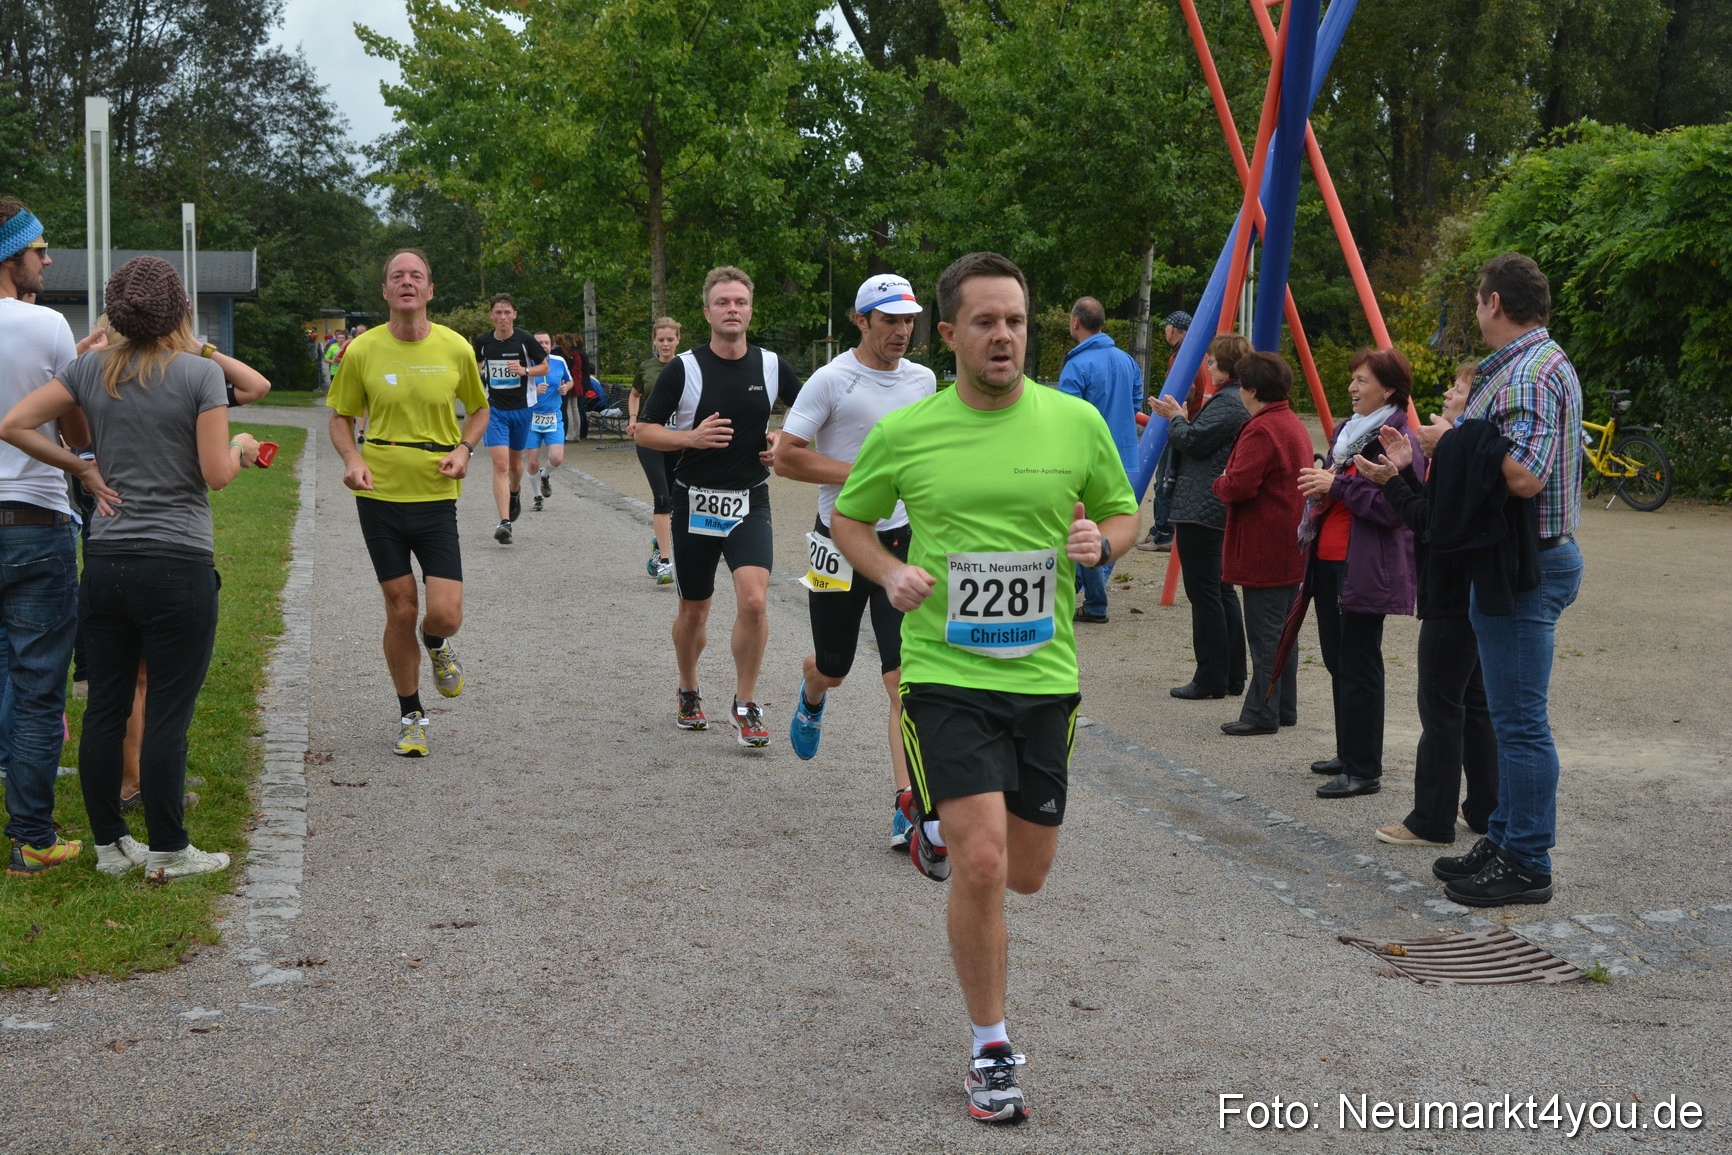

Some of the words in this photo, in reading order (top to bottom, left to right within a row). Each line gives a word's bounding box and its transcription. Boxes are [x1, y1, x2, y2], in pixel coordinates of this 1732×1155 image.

[534, 415, 555, 425] 2732
[1013, 467, 1072, 475] Dorfner-Apotheken
[695, 493, 743, 518] 2862
[950, 561, 986, 573] PARTL
[989, 562, 1043, 573] Neumarkt
[959, 575, 1046, 618] 2281
[970, 627, 1036, 644] Christian
